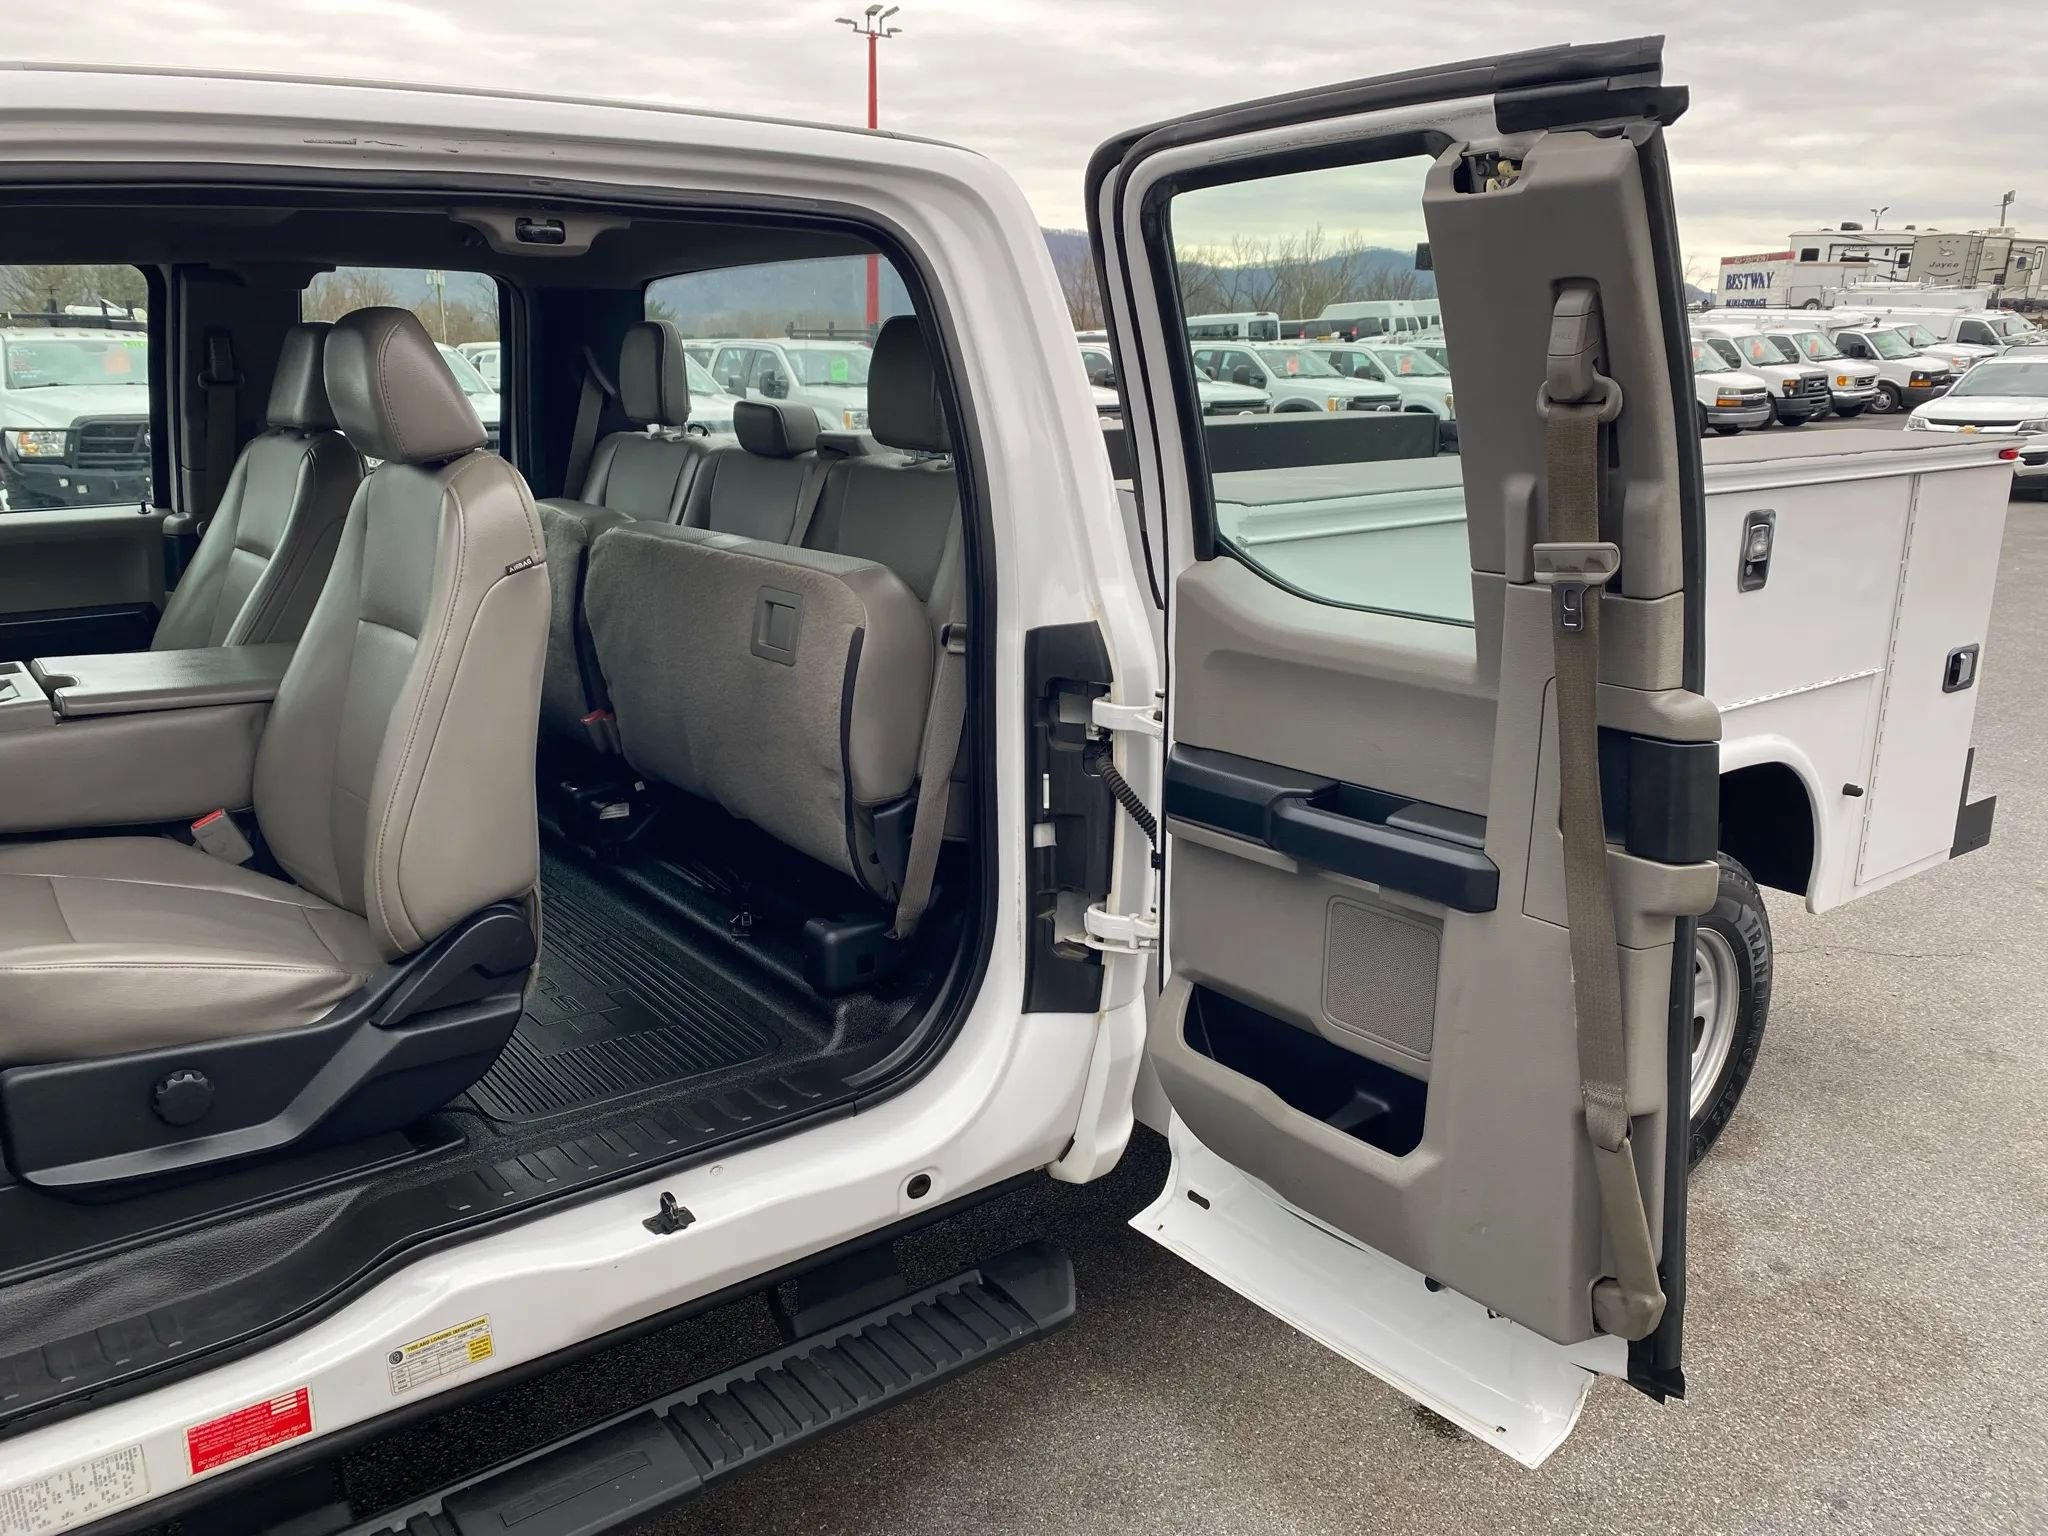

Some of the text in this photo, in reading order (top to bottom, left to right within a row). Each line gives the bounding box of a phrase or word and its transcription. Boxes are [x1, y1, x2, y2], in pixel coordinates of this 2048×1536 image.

[1929, 261, 1960, 269] Jayco
[1726, 272, 1775, 290] BESTWAY
[509, 558, 532, 573] AIRBAG
[1737, 917, 1769, 1074] TRANSFORC
[430, 1331, 451, 1343] LOADING
[452, 1318, 485, 1334] INFORMATION
